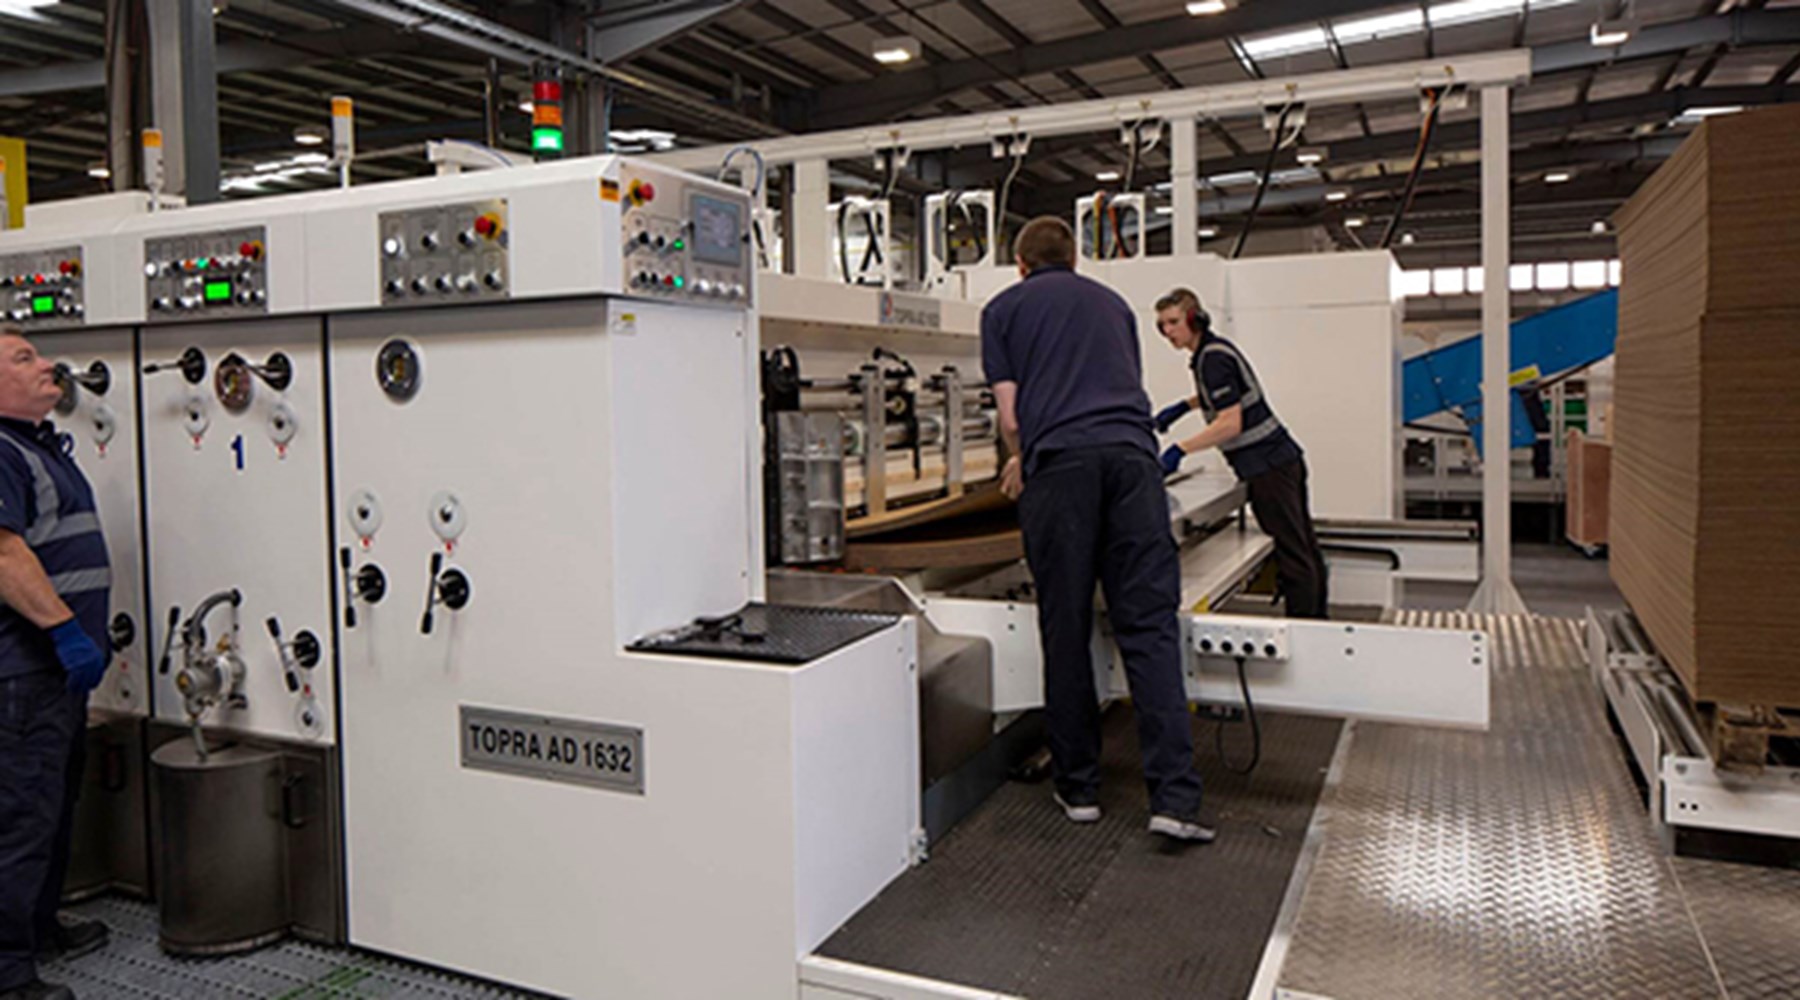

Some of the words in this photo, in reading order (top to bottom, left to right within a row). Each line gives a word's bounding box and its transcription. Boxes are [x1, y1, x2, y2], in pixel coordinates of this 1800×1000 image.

[231, 434, 244, 470] 1
[469, 724, 542, 760] TOPRA
[547, 735, 578, 765] AD
[583, 741, 632, 773] 1632
